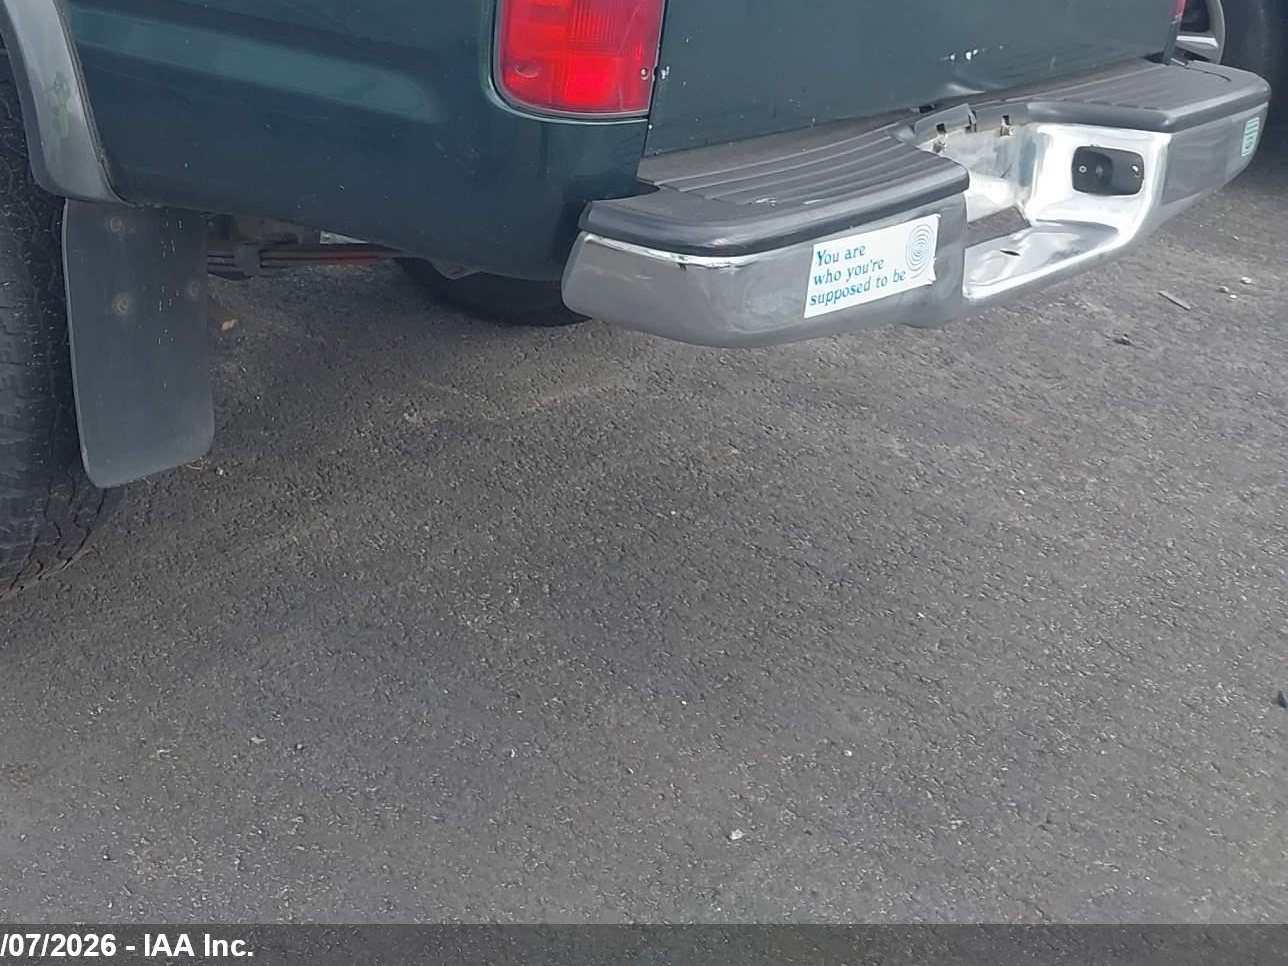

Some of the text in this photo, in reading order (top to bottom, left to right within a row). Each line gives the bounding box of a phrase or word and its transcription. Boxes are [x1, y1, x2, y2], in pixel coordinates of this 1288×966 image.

[816, 245, 866, 267] You are
[813, 258, 885, 287] who you're
[809, 268, 906, 307] supposed to be
